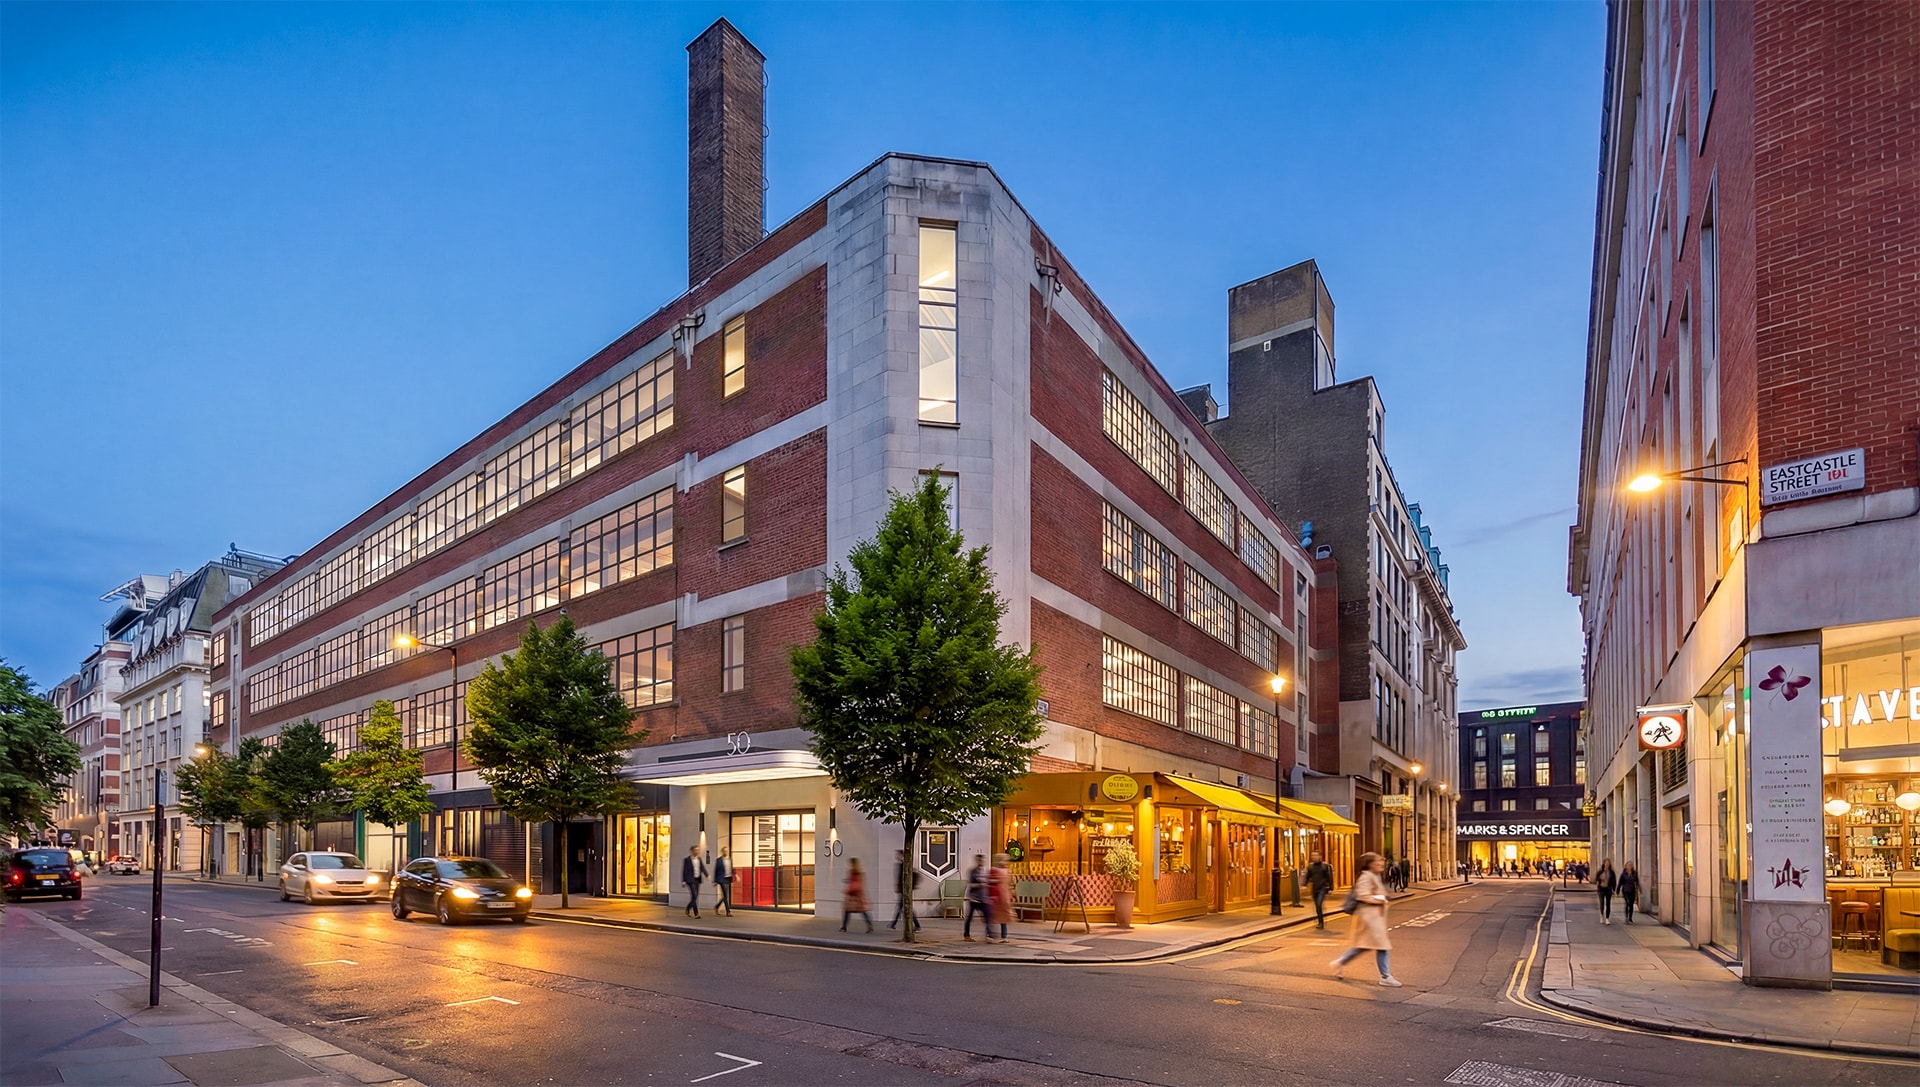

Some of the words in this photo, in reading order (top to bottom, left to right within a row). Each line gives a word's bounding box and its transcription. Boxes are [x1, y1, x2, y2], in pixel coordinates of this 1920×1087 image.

[1770, 454, 1857, 481] EASTCASTLE
[1770, 473, 1821, 493] STREET
[727, 731, 751, 756] 50
[1457, 825, 1498, 835] MARKS
[1499, 825, 1508, 835] &
[1508, 824, 1569, 835] SPENCER
[824, 839, 844, 858] 50
